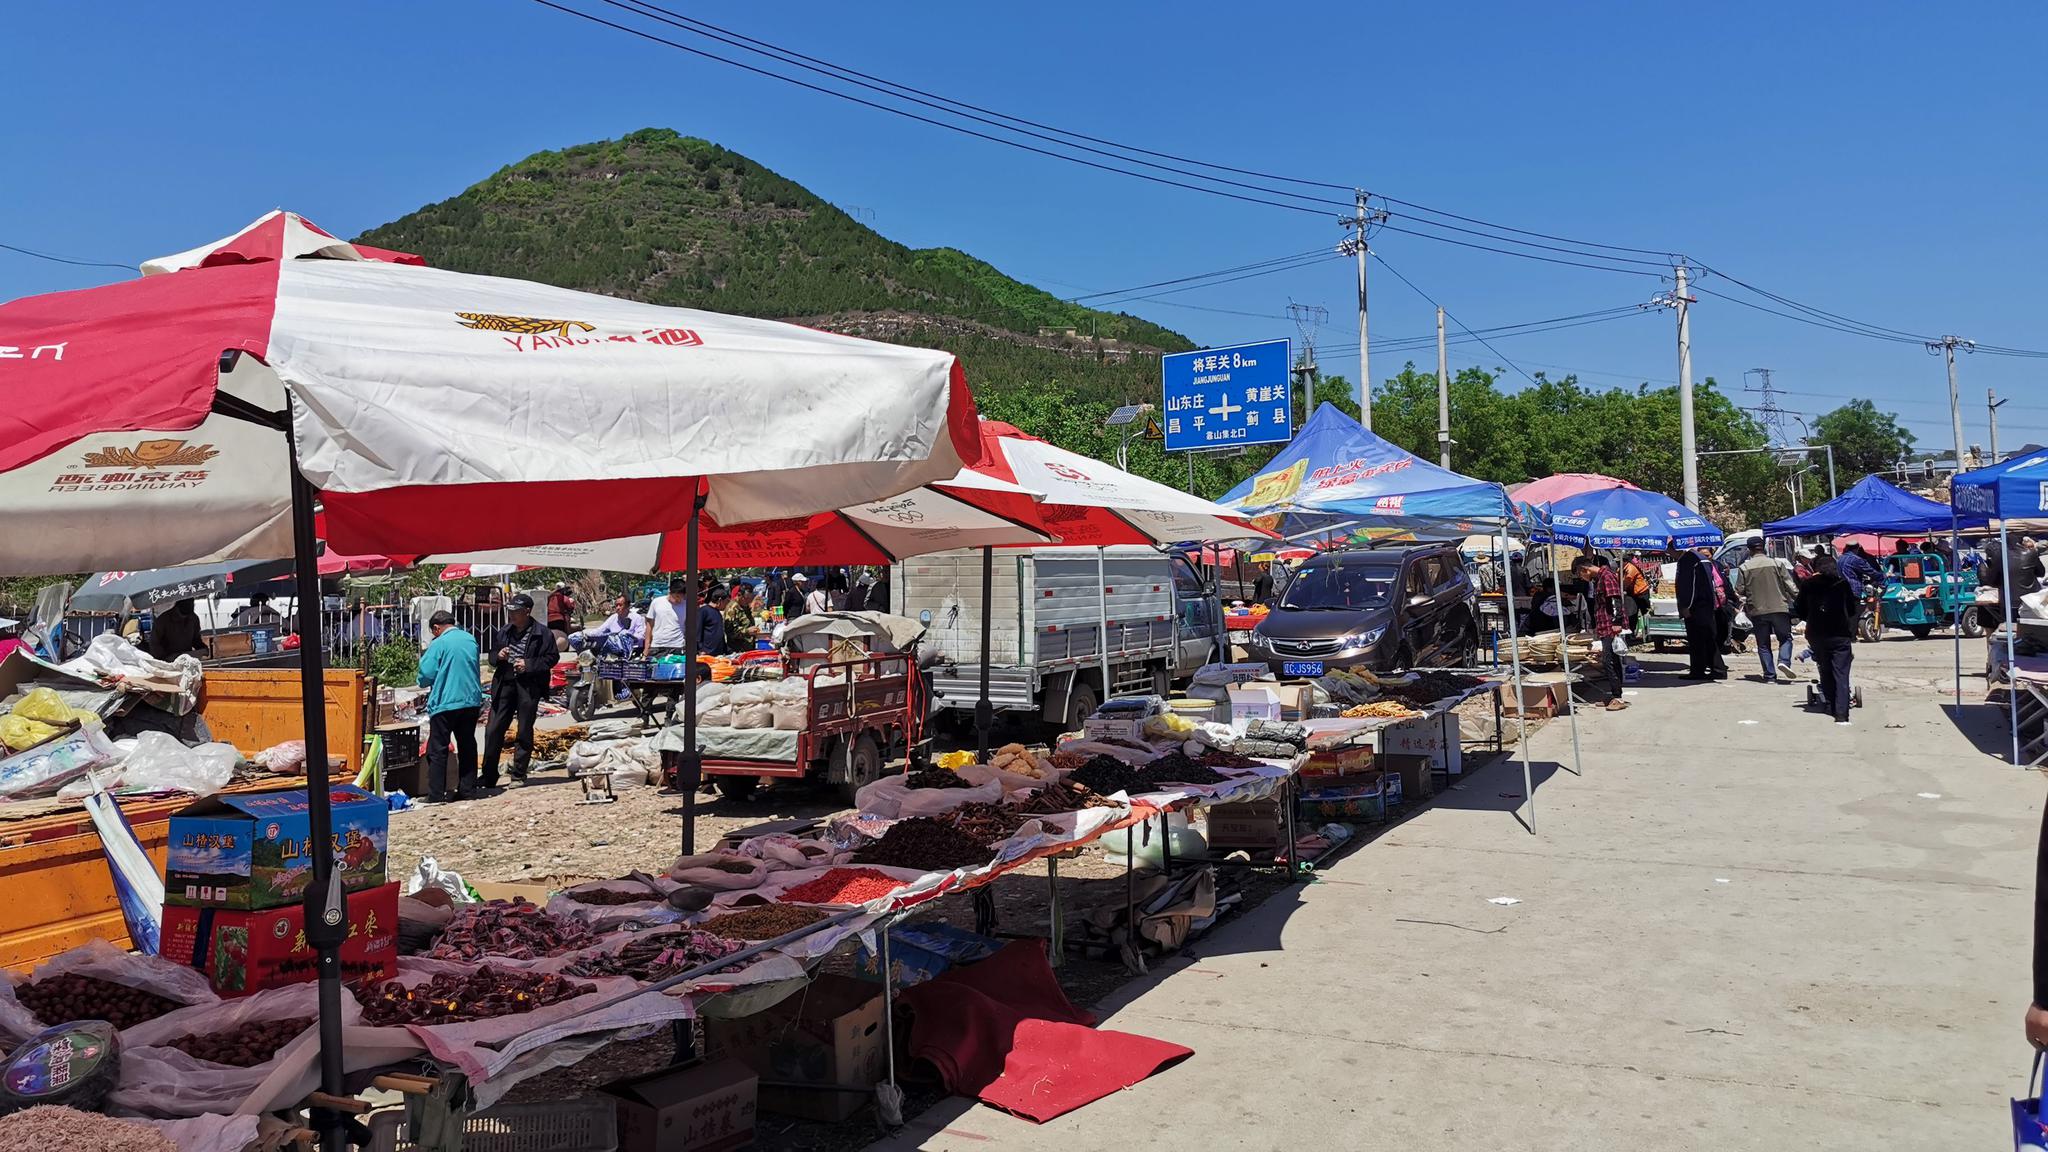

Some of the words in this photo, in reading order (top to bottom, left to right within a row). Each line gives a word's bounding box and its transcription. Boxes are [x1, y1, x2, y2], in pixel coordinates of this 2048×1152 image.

[1192, 354, 1230, 373] 将军关
[1193, 373, 1231, 385] JIANGJUNGUAN
[1167, 394, 1205, 412] 山东庄
[1245, 385, 1286, 403] 黄崖关
[1168, 416, 1206, 434] 昌平
[1246, 408, 1287, 427] 蓟县
[148, 580, 216, 603] 农夫山泉有点甜
[182, 833, 236, 849] 山楂汉堡
